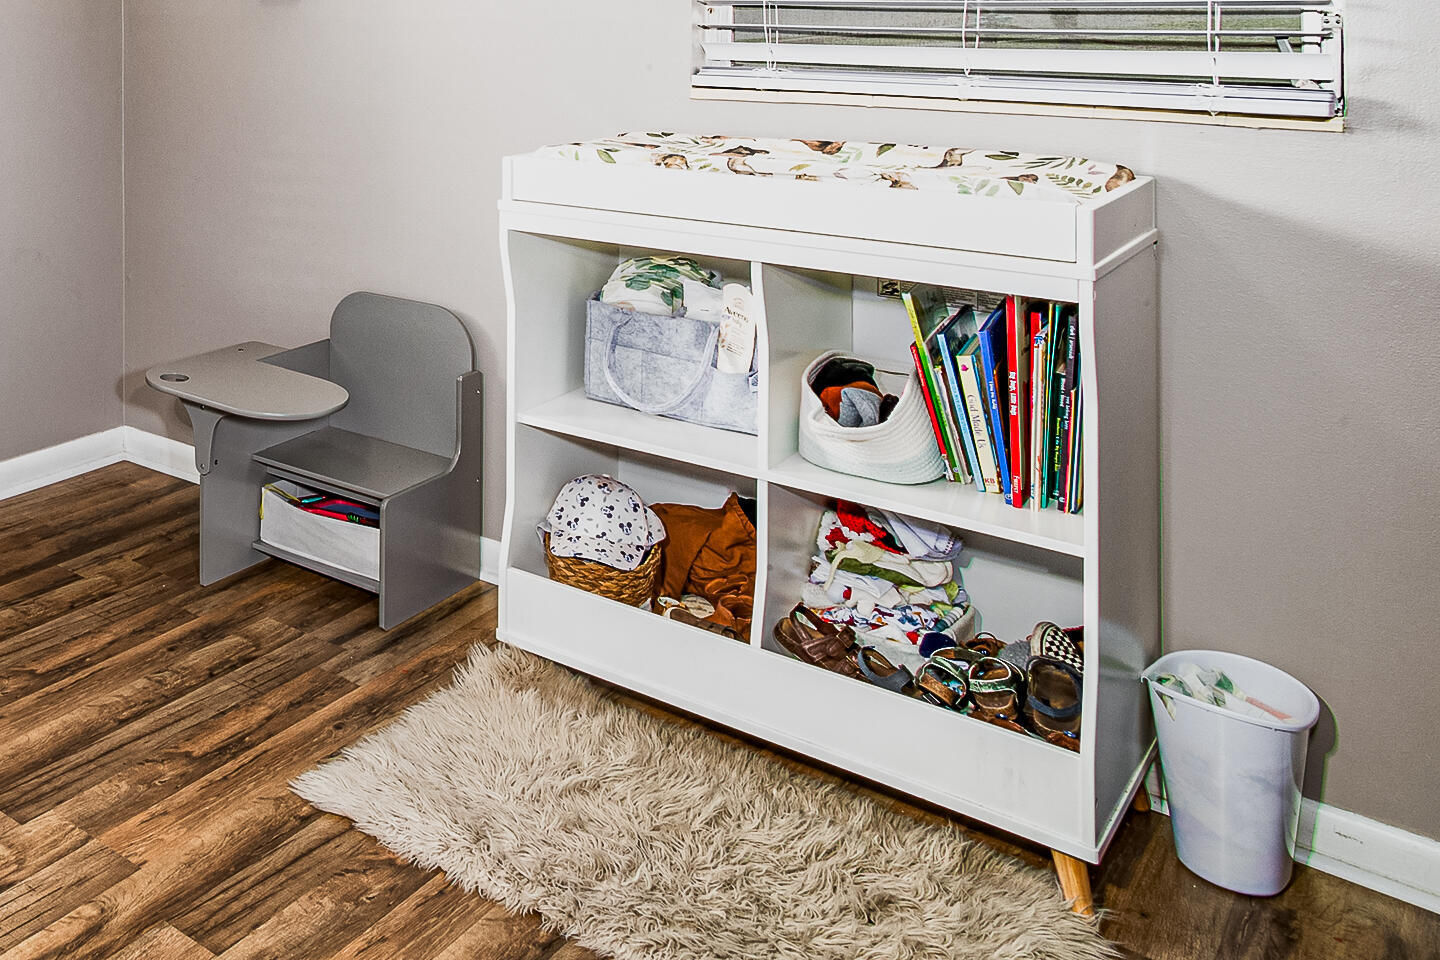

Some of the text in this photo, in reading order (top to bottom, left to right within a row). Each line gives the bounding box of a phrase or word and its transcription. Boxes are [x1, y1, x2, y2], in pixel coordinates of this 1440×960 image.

[967, 394, 986, 449] God Made Us
